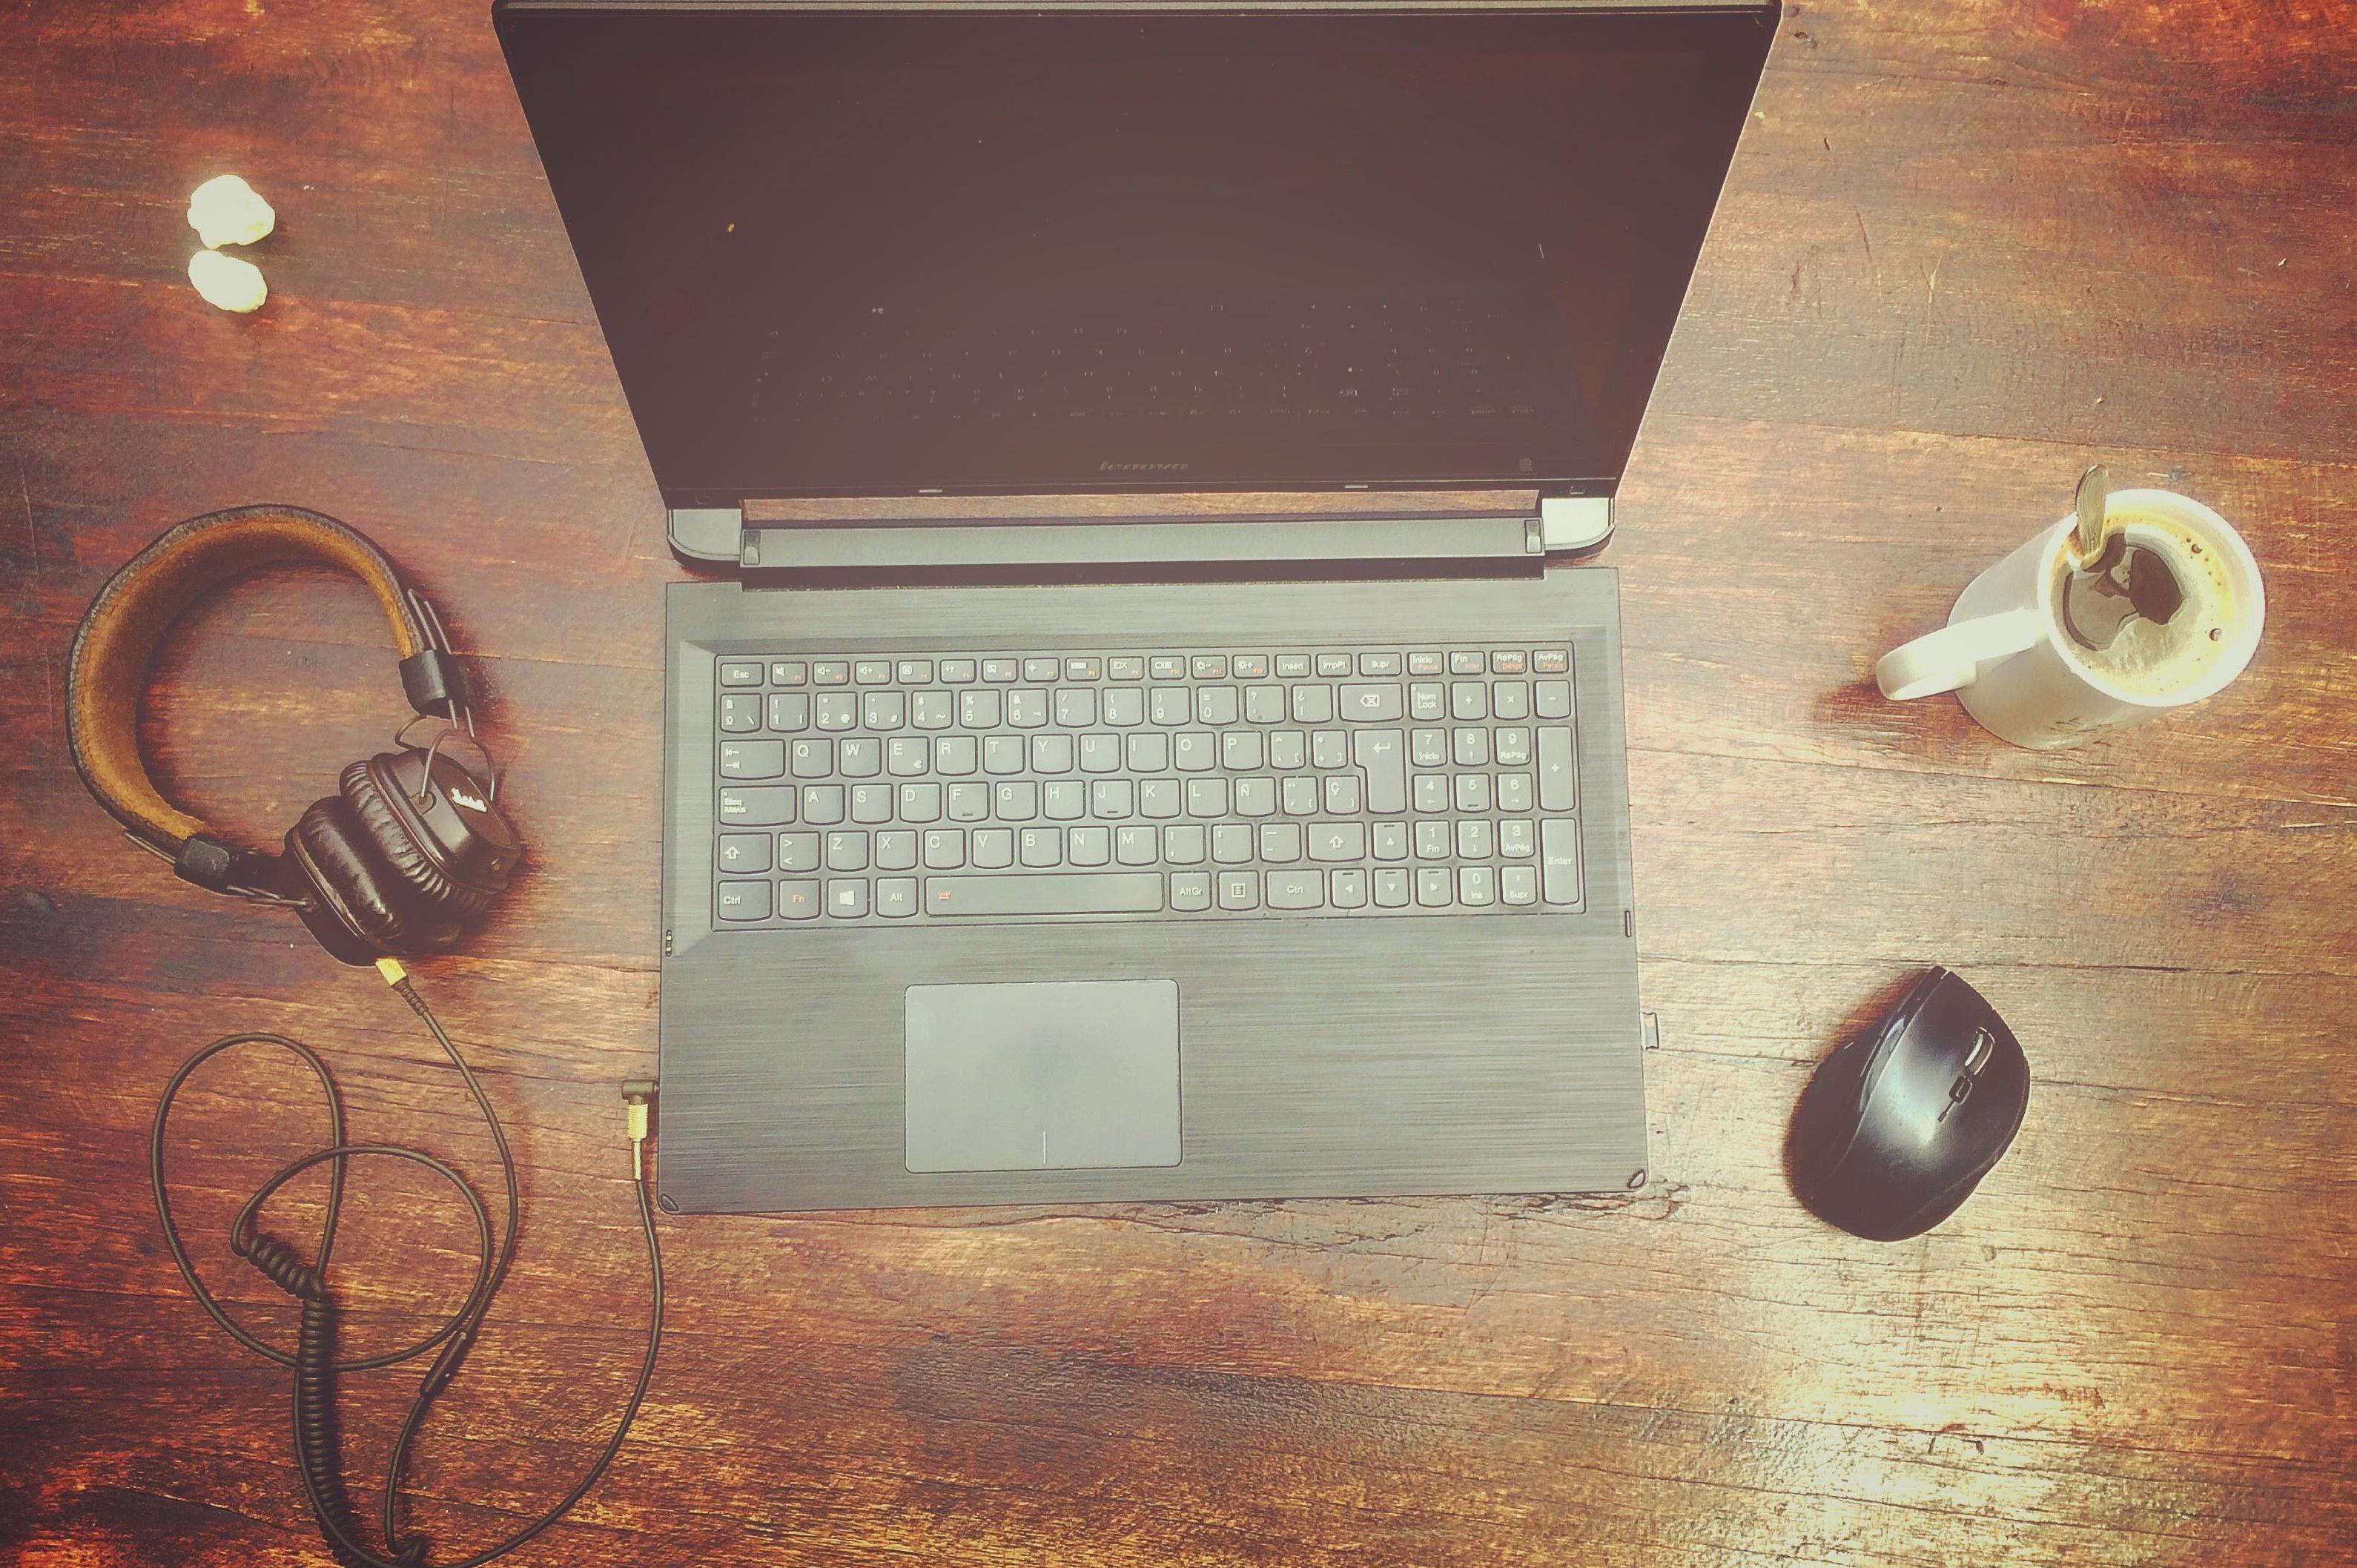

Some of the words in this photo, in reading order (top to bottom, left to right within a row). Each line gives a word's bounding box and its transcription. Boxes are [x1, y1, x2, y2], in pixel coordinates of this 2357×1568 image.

[1412, 655, 1433, 664] Inicio
[1454, 654, 1468, 664] Fin
[1282, 662, 1304, 670] Insert
[1371, 661, 1390, 670] Supr
[733, 670, 750, 679] Esc
[965, 695, 974, 705] %
[1111, 694, 1115, 704] (
[1158, 693, 1163, 704] )
[1251, 692, 1258, 701] ?
[1297, 691, 1306, 701] ¿
[1418, 701, 1437, 709] Lock
[822, 712, 830, 724] 2
[870, 712, 878, 724] 3
[917, 711, 925, 722] 4
[965, 710, 973, 721] 5
[1013, 709, 1021, 721] 6
[1061, 709, 1069, 719] 7
[1109, 708, 1117, 720] 8
[1157, 707, 1165, 719] 9
[1204, 707, 1212, 718] 0
[774, 714, 779, 724] 1
[1227, 738, 1237, 750] P
[1424, 734, 1432, 745] 7
[1467, 733, 1475, 744] 8
[1508, 733, 1517, 744] 9
[845, 744, 860, 756] W
[893, 743, 903, 755] E
[941, 743, 951, 755] R
[989, 741, 999, 753] T
[1038, 741, 1048, 753] Y
[1085, 740, 1095, 752] U
[1132, 740, 1137, 752] I
[1180, 738, 1192, 751] O
[796, 745, 809, 758] Q
[1418, 751, 1440, 760] Inicio
[1551, 764, 1559, 772] +
[1330, 782, 1340, 795] Ç
[1427, 780, 1435, 791] 4
[1468, 780, 1477, 790] 5
[1510, 779, 1519, 790] 6
[905, 790, 916, 802] D
[953, 789, 962, 801] F
[1002, 788, 1013, 801] G
[1049, 787, 1060, 799] H
[1098, 786, 1106, 798] J
[1146, 785, 1156, 798] K
[1192, 784, 1201, 797] L
[1240, 784, 1250, 797] Ñ
[808, 791, 819, 803] A
[856, 790, 867, 803] S
[1429, 827, 1435, 838] 1
[1470, 826, 1479, 838] 2
[1512, 825, 1521, 837] 3
[784, 839, 793, 847] >
[832, 837, 843, 850] Z
[881, 836, 891, 850] X
[929, 836, 940, 848] C
[977, 835, 988, 847] V
[1025, 834, 1036, 846] B
[1074, 833, 1085, 846] N
[1122, 832, 1134, 844] M
[1426, 844, 1440, 853] Fin
[784, 857, 793, 865] <
[1547, 856, 1572, 866] Enter
[1472, 873, 1481, 884] 0
[1180, 887, 1203, 896] AltGr
[1286, 885, 1304, 895] Ctrl
[1471, 890, 1483, 899] Ins
[1510, 890, 1529, 900] Supr
[723, 896, 741, 906] Ctrl
[791, 894, 806, 903] Fn
[890, 893, 903, 902] Alt
